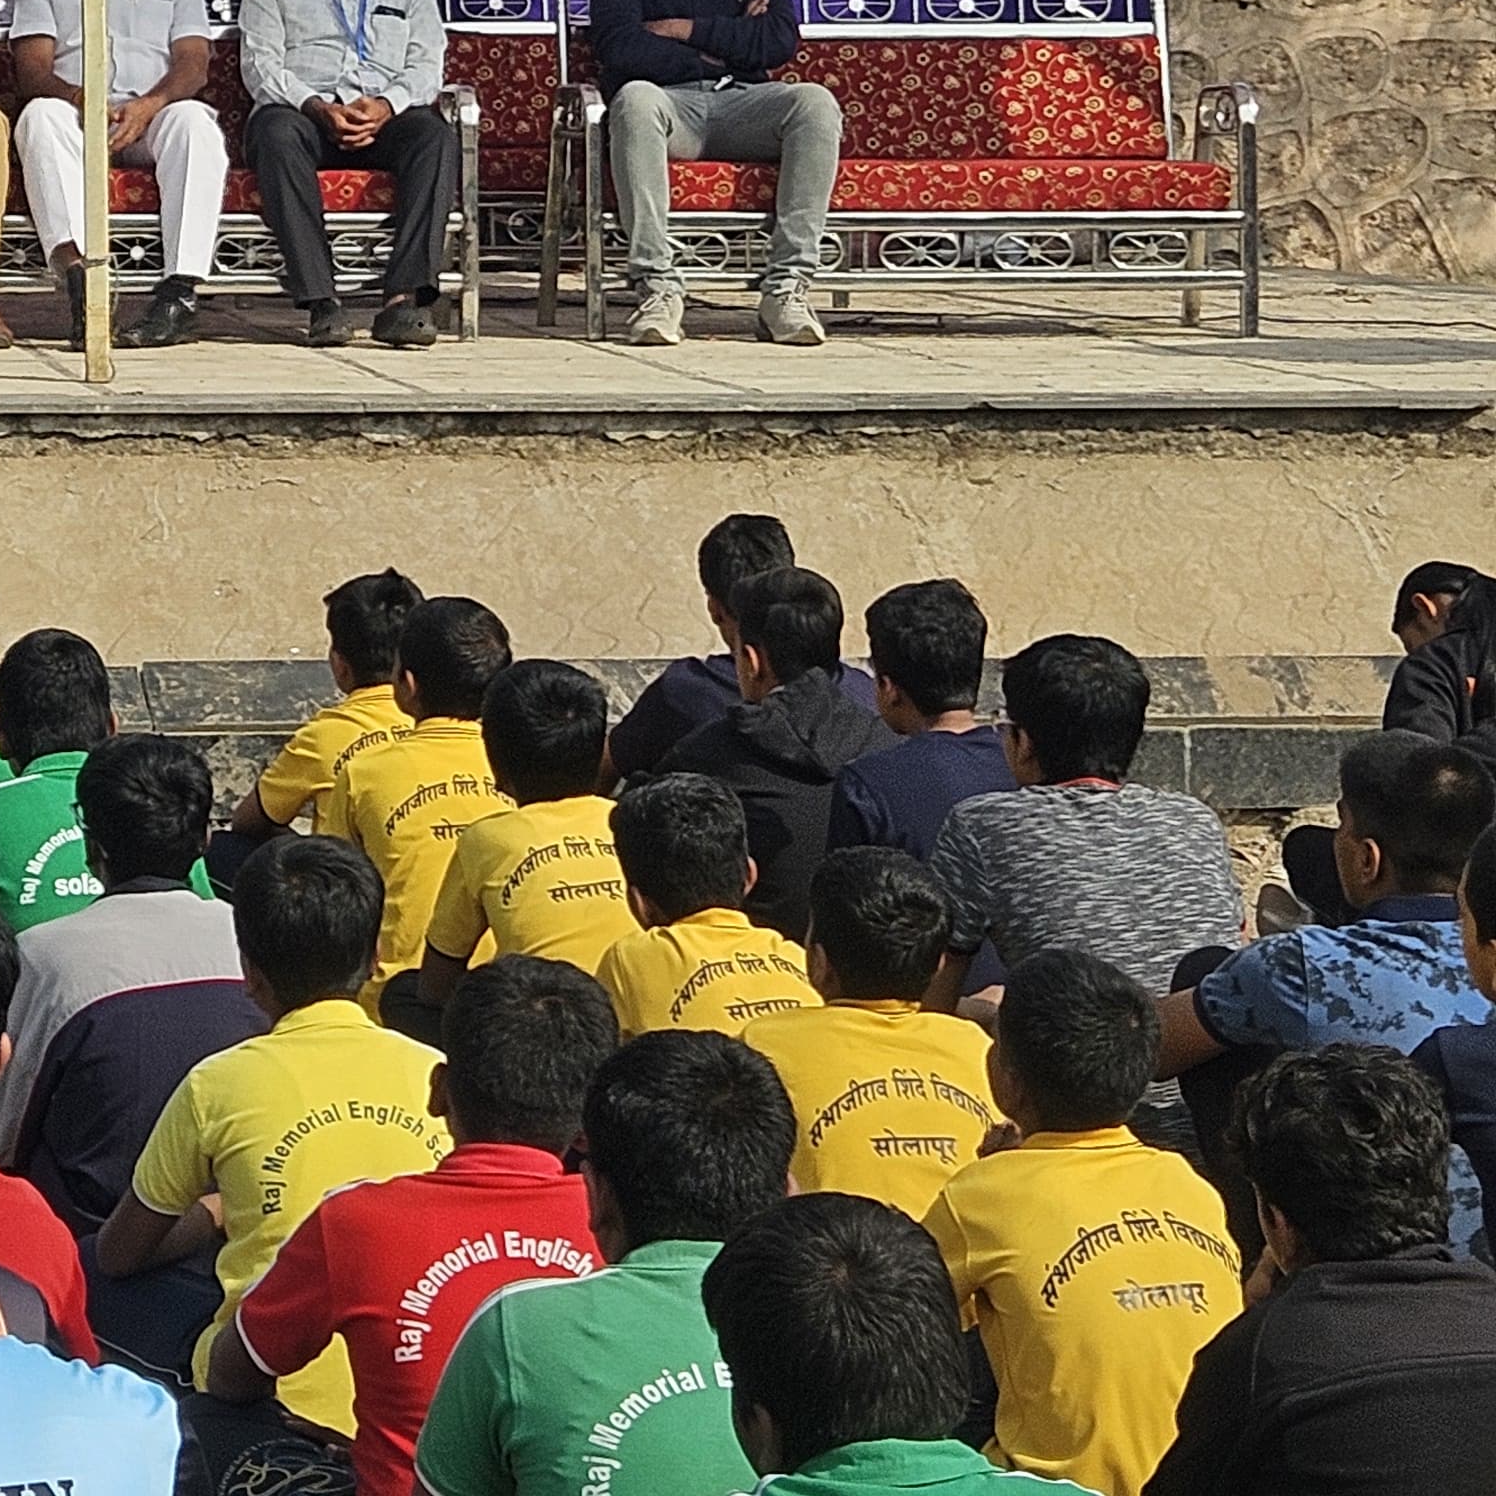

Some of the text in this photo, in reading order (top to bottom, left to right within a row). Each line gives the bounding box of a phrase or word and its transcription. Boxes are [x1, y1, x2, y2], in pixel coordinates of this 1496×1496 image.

[452, 773, 479, 796] शिंदे
[563, 835, 594, 858] शिंदे
[19, 877, 43, 905] Raj
[547, 880, 624, 903] सोलापूर
[735, 951, 772, 974] शिंदे
[891, 1067, 928, 1100] शिंदे
[259, 1100, 425, 1216] Raj Memorial English
[869, 1127, 958, 1164] सोलापूर
[1121, 1208, 1169, 1243] शिंदे
[394, 1231, 594, 1363] Raj Memorial English
[1112, 1278, 1209, 1315] सोलापूर
[588, 1362, 707, 1451] Memorial
